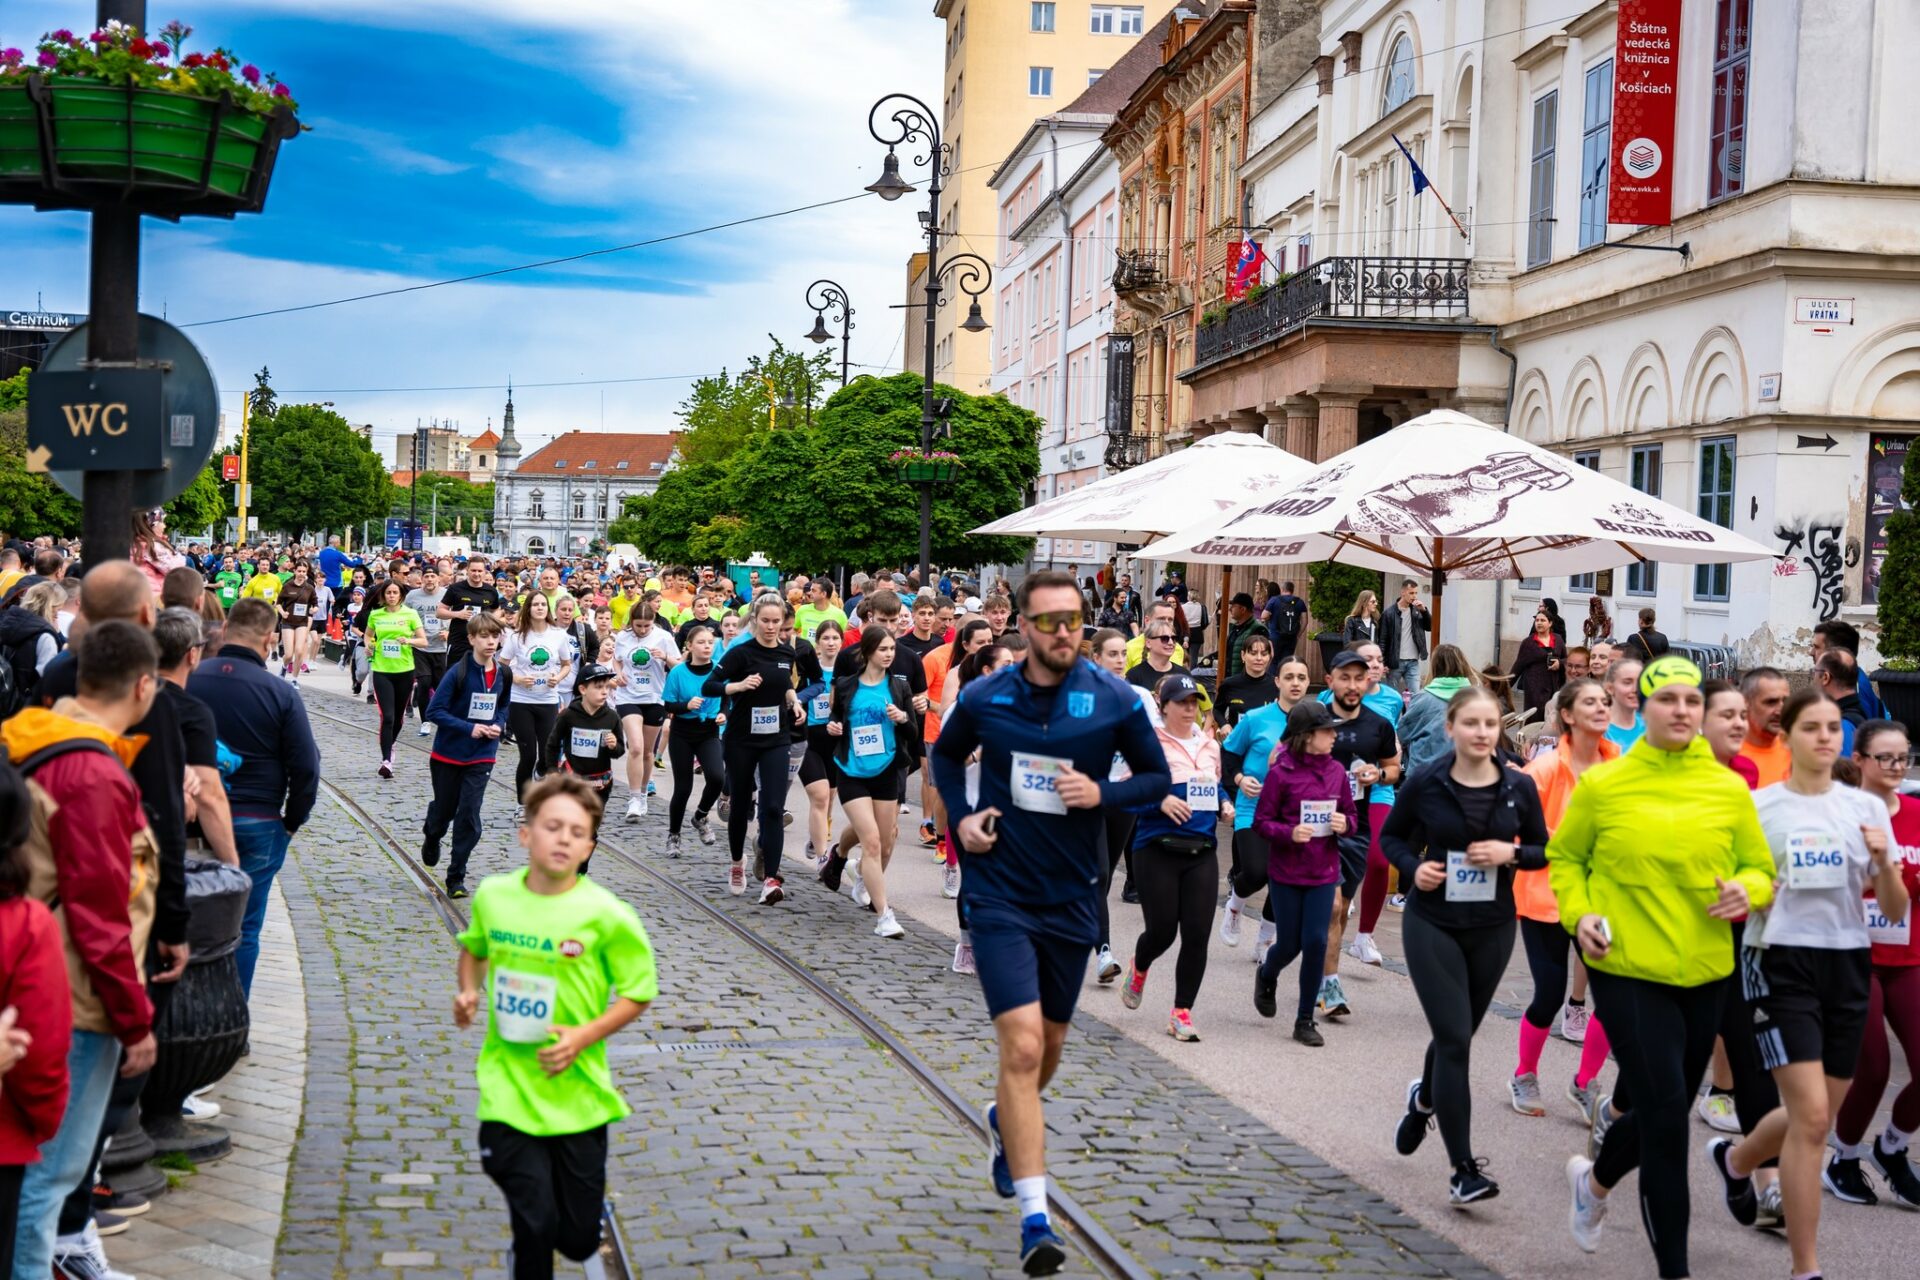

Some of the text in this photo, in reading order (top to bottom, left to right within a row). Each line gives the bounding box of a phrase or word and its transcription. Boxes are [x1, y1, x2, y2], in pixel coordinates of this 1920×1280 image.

[1629, 21, 1668, 34] Štátna
[1625, 38, 1671, 49] vedecká
[1624, 52, 1670, 64] knižnica
[1643, 70, 1650, 78] v
[1620, 81, 1672, 94] Košiciach
[9, 312, 68, 326] CENTRUM
[61, 403, 127, 437] WC
[1592, 518, 1715, 542] BERNARD
[471, 701, 495, 711] 1393
[754, 714, 778, 724] 1389
[572, 737, 597, 747] 1394
[858, 735, 878, 745] 395
[1189, 786, 1215, 797] 2160
[1792, 850, 1843, 868] 1546
[1456, 869, 1488, 884] 971
[496, 992, 548, 1019] 1360
